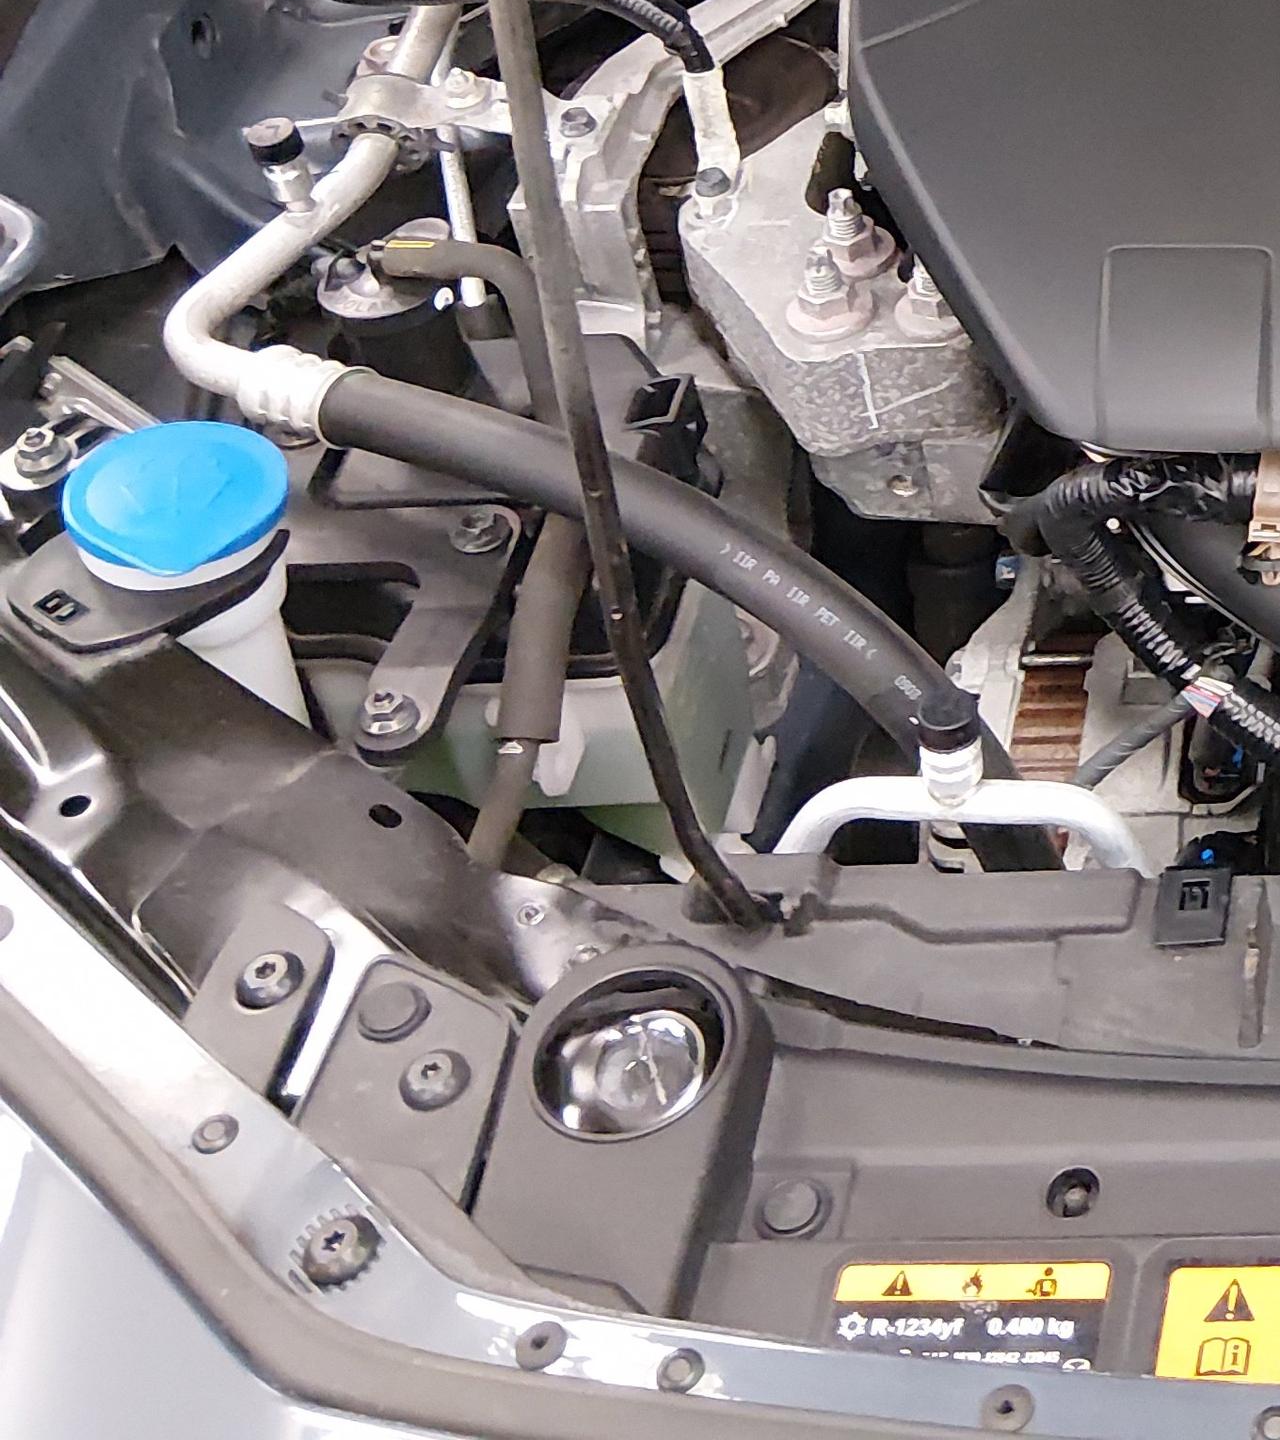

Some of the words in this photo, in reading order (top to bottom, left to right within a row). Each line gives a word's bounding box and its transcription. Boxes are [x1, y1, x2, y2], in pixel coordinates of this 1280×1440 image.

[814, 606, 841, 626] PET
[869, 1317, 965, 1341] R-1234yf
[1047, 1316, 1075, 1339] kg
